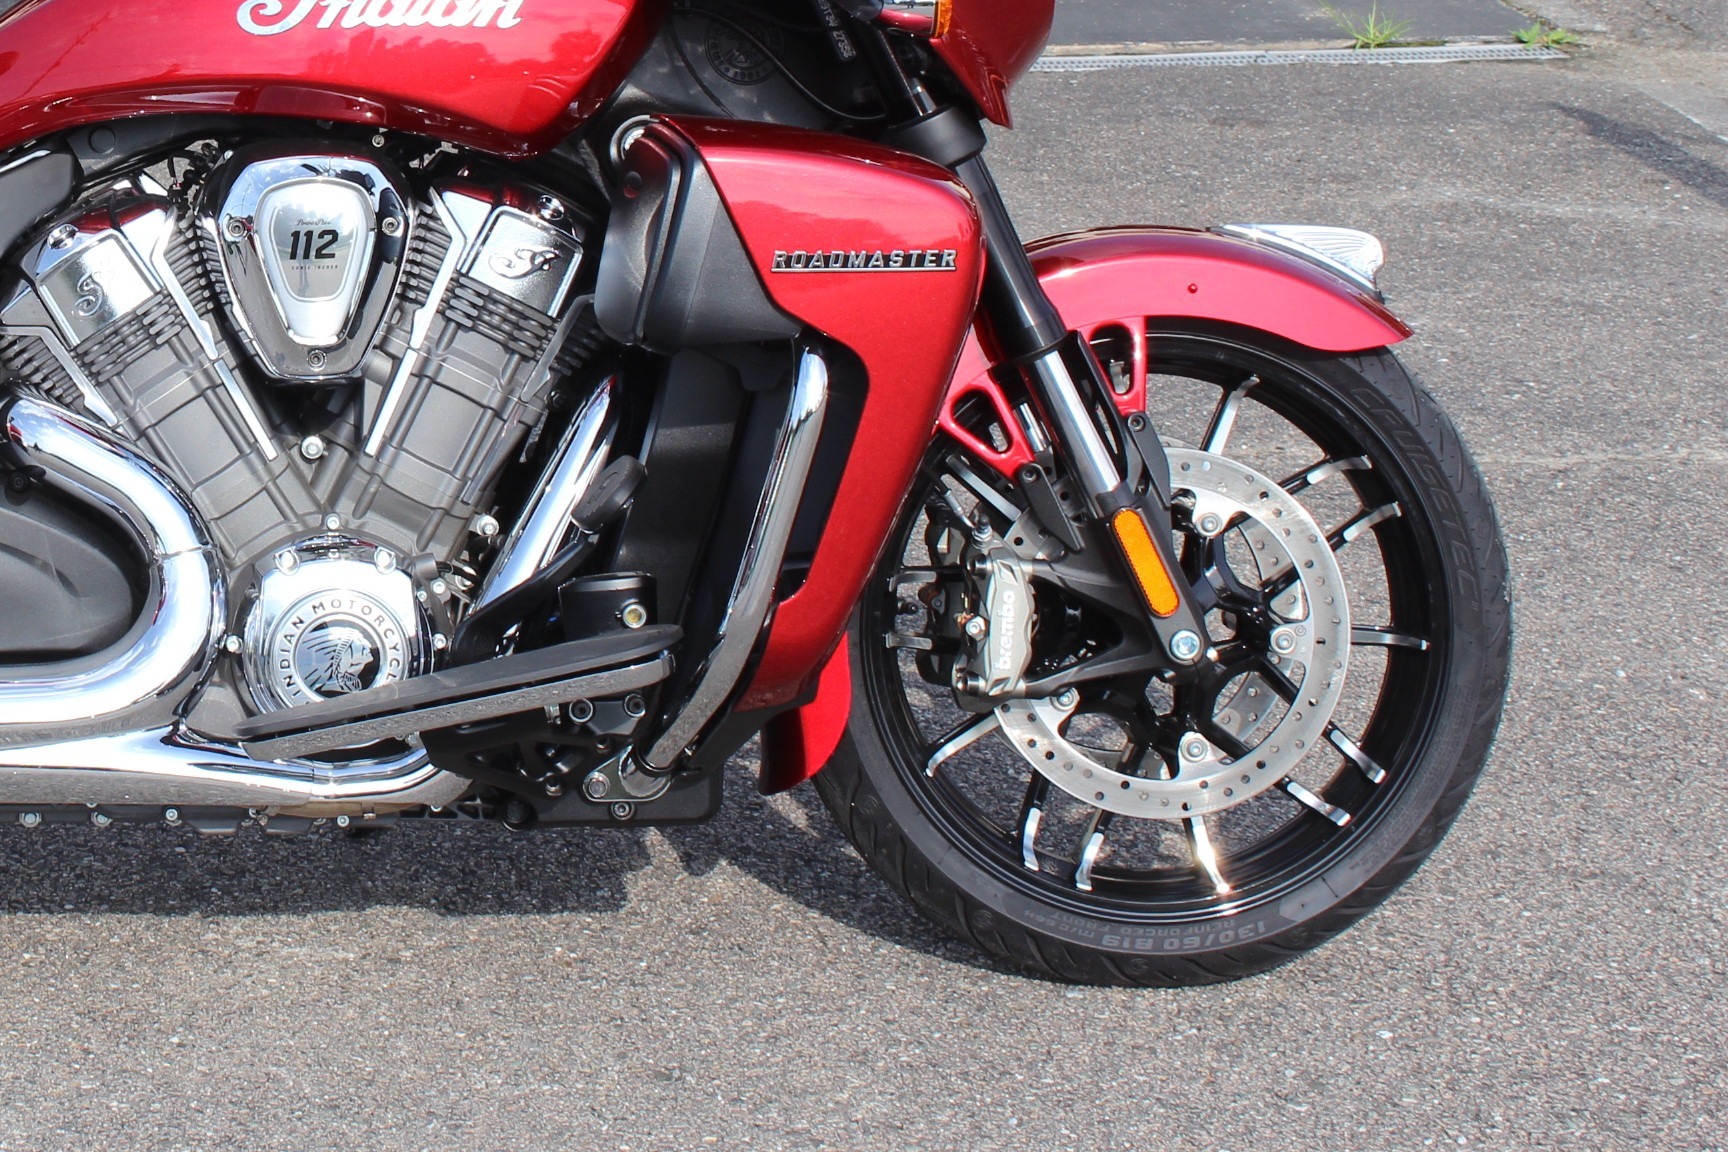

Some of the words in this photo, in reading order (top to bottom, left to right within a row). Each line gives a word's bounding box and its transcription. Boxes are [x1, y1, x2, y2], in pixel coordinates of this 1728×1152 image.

[289, 229, 339, 260] 112
[772, 249, 957, 268] ROADMASTER
[994, 590, 1016, 670] brembo
[279, 616, 305, 698] INDIAN
[311, 598, 401, 680] MOTORCYCL
[1048, 911, 1110, 932] FRONT
[1120, 918, 1236, 936] REINFORCED
[1163, 920, 1266, 950] 130/60
